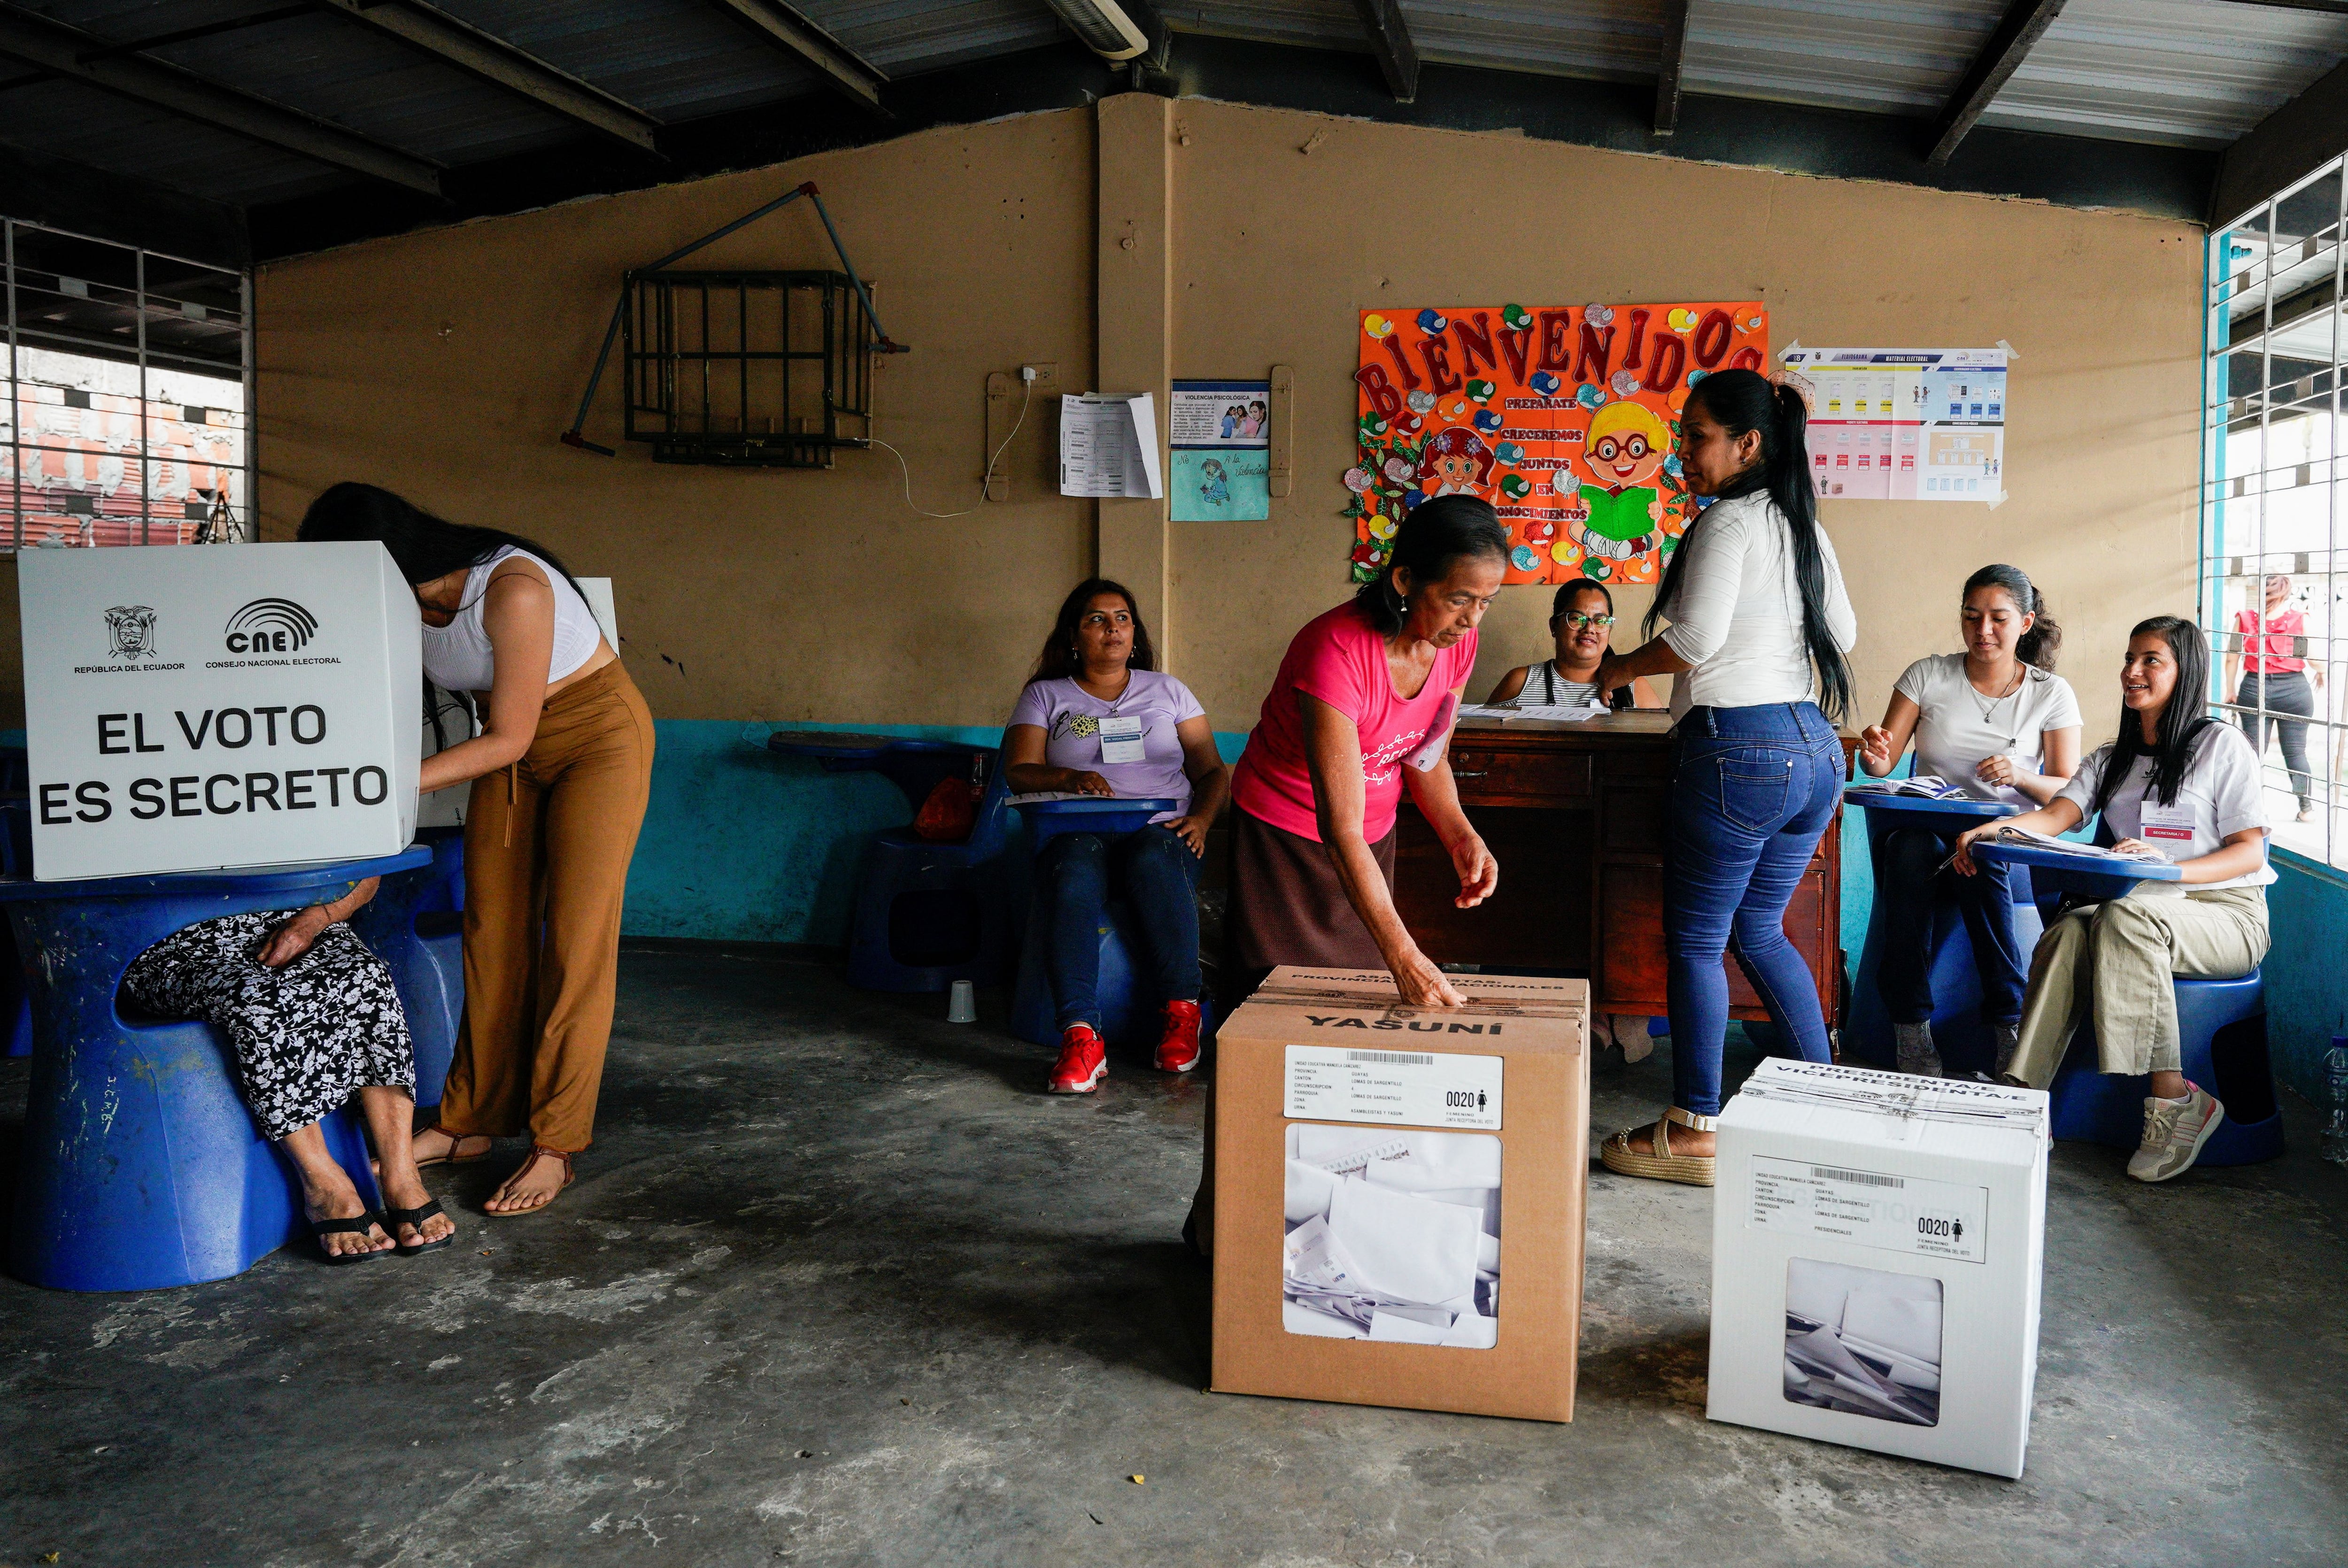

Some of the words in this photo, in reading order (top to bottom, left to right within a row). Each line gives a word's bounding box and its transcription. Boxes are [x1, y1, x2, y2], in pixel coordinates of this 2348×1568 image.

[1501, 430, 1583, 441] CRECEREMOS
[1521, 459, 1570, 470] JUNTOS
[1538, 485, 1554, 495] EN
[1496, 507, 1587, 521] ONOCIMIENTOS
[74, 665, 123, 674] REPÚBLICA
[206, 660, 246, 669] CONSEJO
[98, 712, 164, 755] EL
[174, 704, 326, 751] VOTO
[39, 781, 111, 825] ES
[129, 765, 388, 820] SECRETO
[1304, 1015, 1504, 1036] YASUNÍ
[1776, 1065, 2028, 1101] VICEPRESIDENTA/E
[1809, 1065, 1997, 1092] PRESIDENTA/E
[1446, 1091, 1475, 1108] 0020
[1839, 1199, 1870, 1208] SARGENTILLO
[1838, 1214, 1869, 1223] SARGENTILLO
[1814, 1226, 1852, 1236] PRESIDENCIALES
[1918, 1217, 1949, 1237] 0020
[1917, 1238, 1949, 1246] FEMENINO
